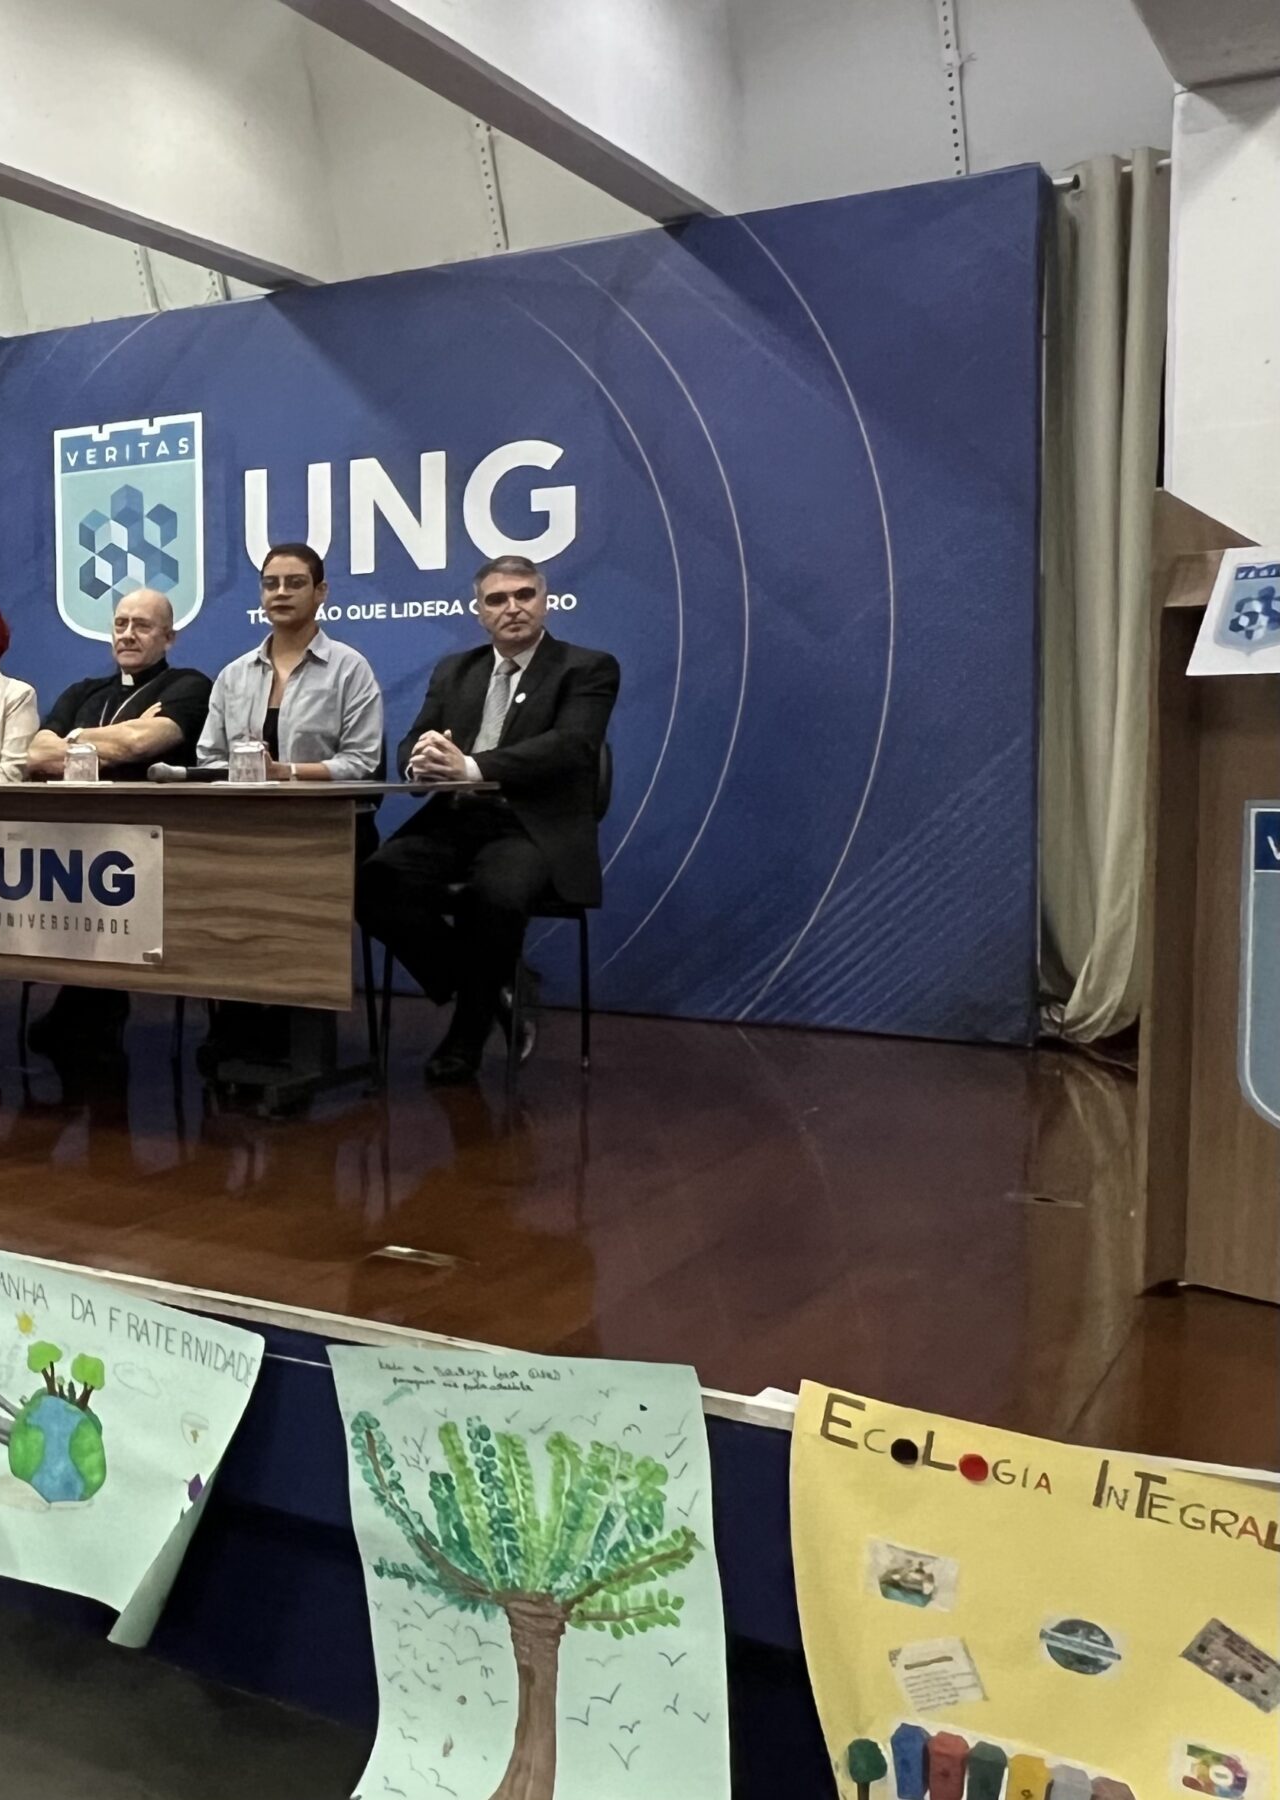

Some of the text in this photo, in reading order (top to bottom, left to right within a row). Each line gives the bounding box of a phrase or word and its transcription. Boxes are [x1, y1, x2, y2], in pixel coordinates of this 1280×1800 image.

[66, 437, 189, 467] VERITAS
[244, 439, 577, 576] UNG
[346, 603, 387, 620] QUE
[391, 599, 464, 619] LIDERA
[71, 1292, 97, 1327] DA
[109, 1306, 257, 1389] FRATERNIDADE
